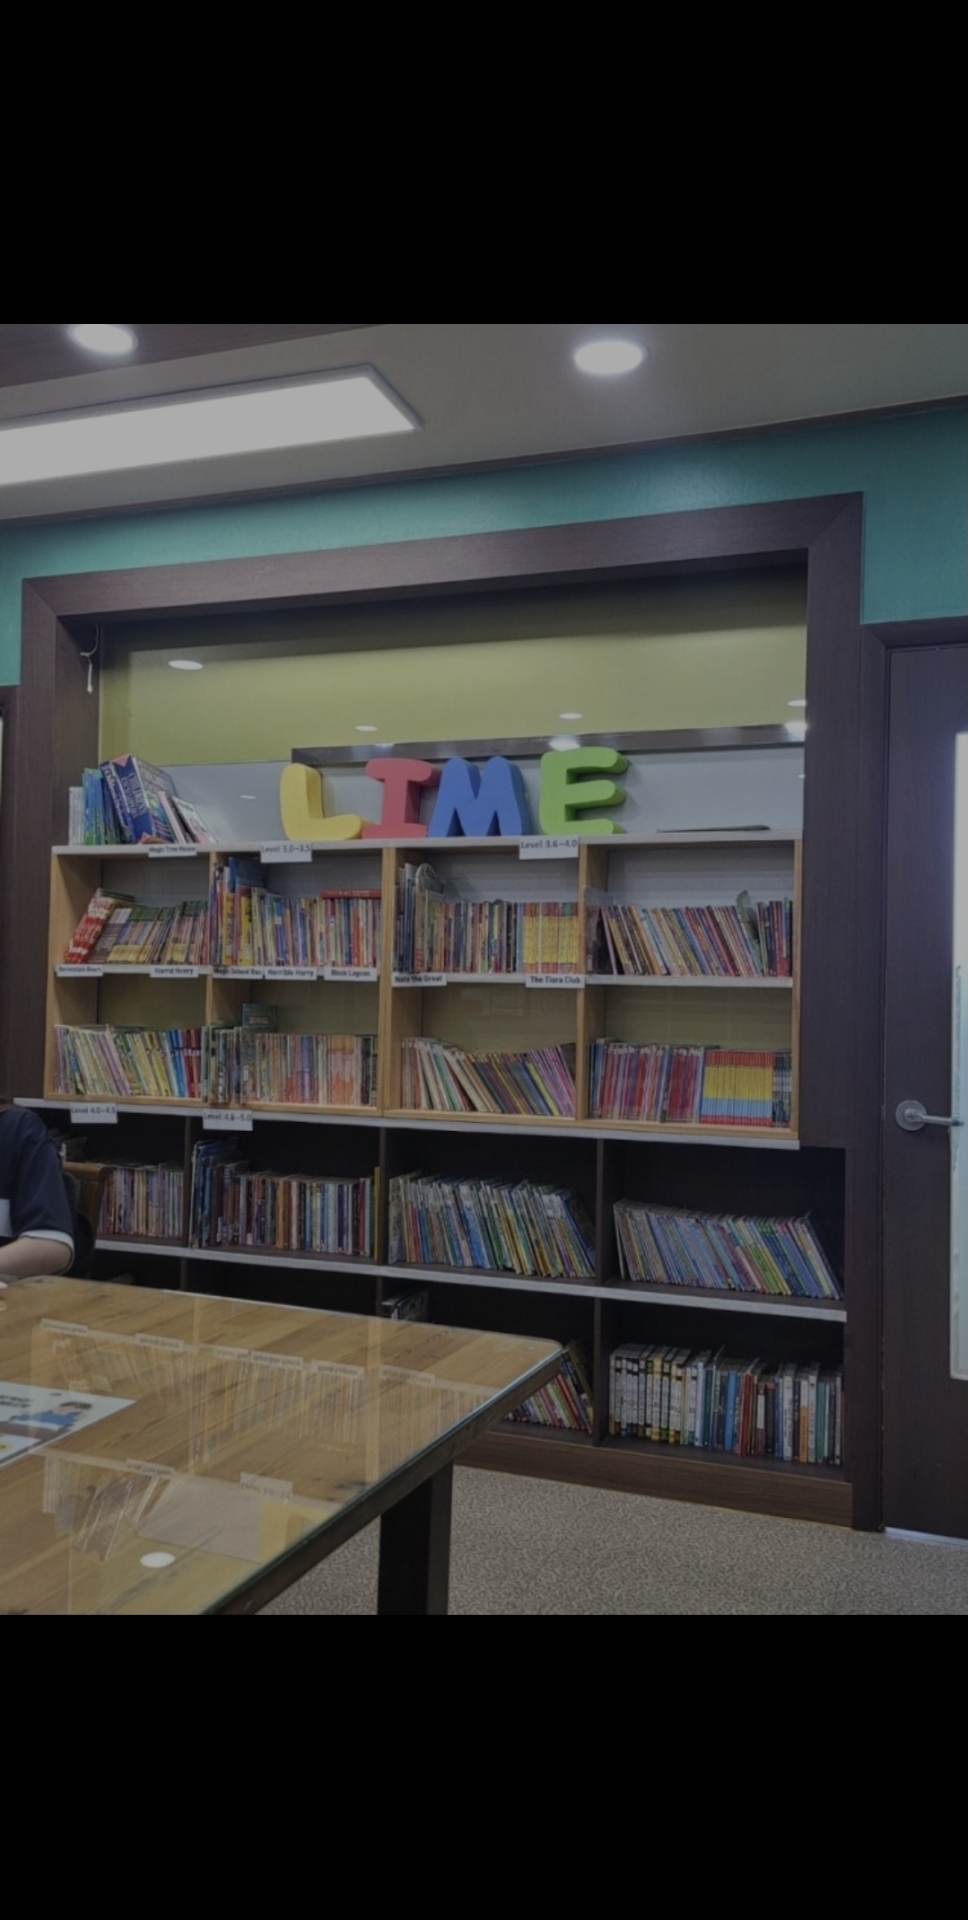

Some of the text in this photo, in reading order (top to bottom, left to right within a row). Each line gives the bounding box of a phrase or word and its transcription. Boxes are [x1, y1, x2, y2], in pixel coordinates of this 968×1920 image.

[280, 746, 628, 841] LIME
[521, 840, 543, 849] Level
[149, 846, 165, 854] Magic
[261, 845, 281, 853] Level
[175, 967, 194, 975] Henry
[267, 968, 314, 977] Horrible Harry
[348, 969, 371, 978] Lagoon
[530, 976, 581, 984] The Tiara Club
[71, 1106, 88, 1114] Level
[203, 1112, 222, 1120] Level
